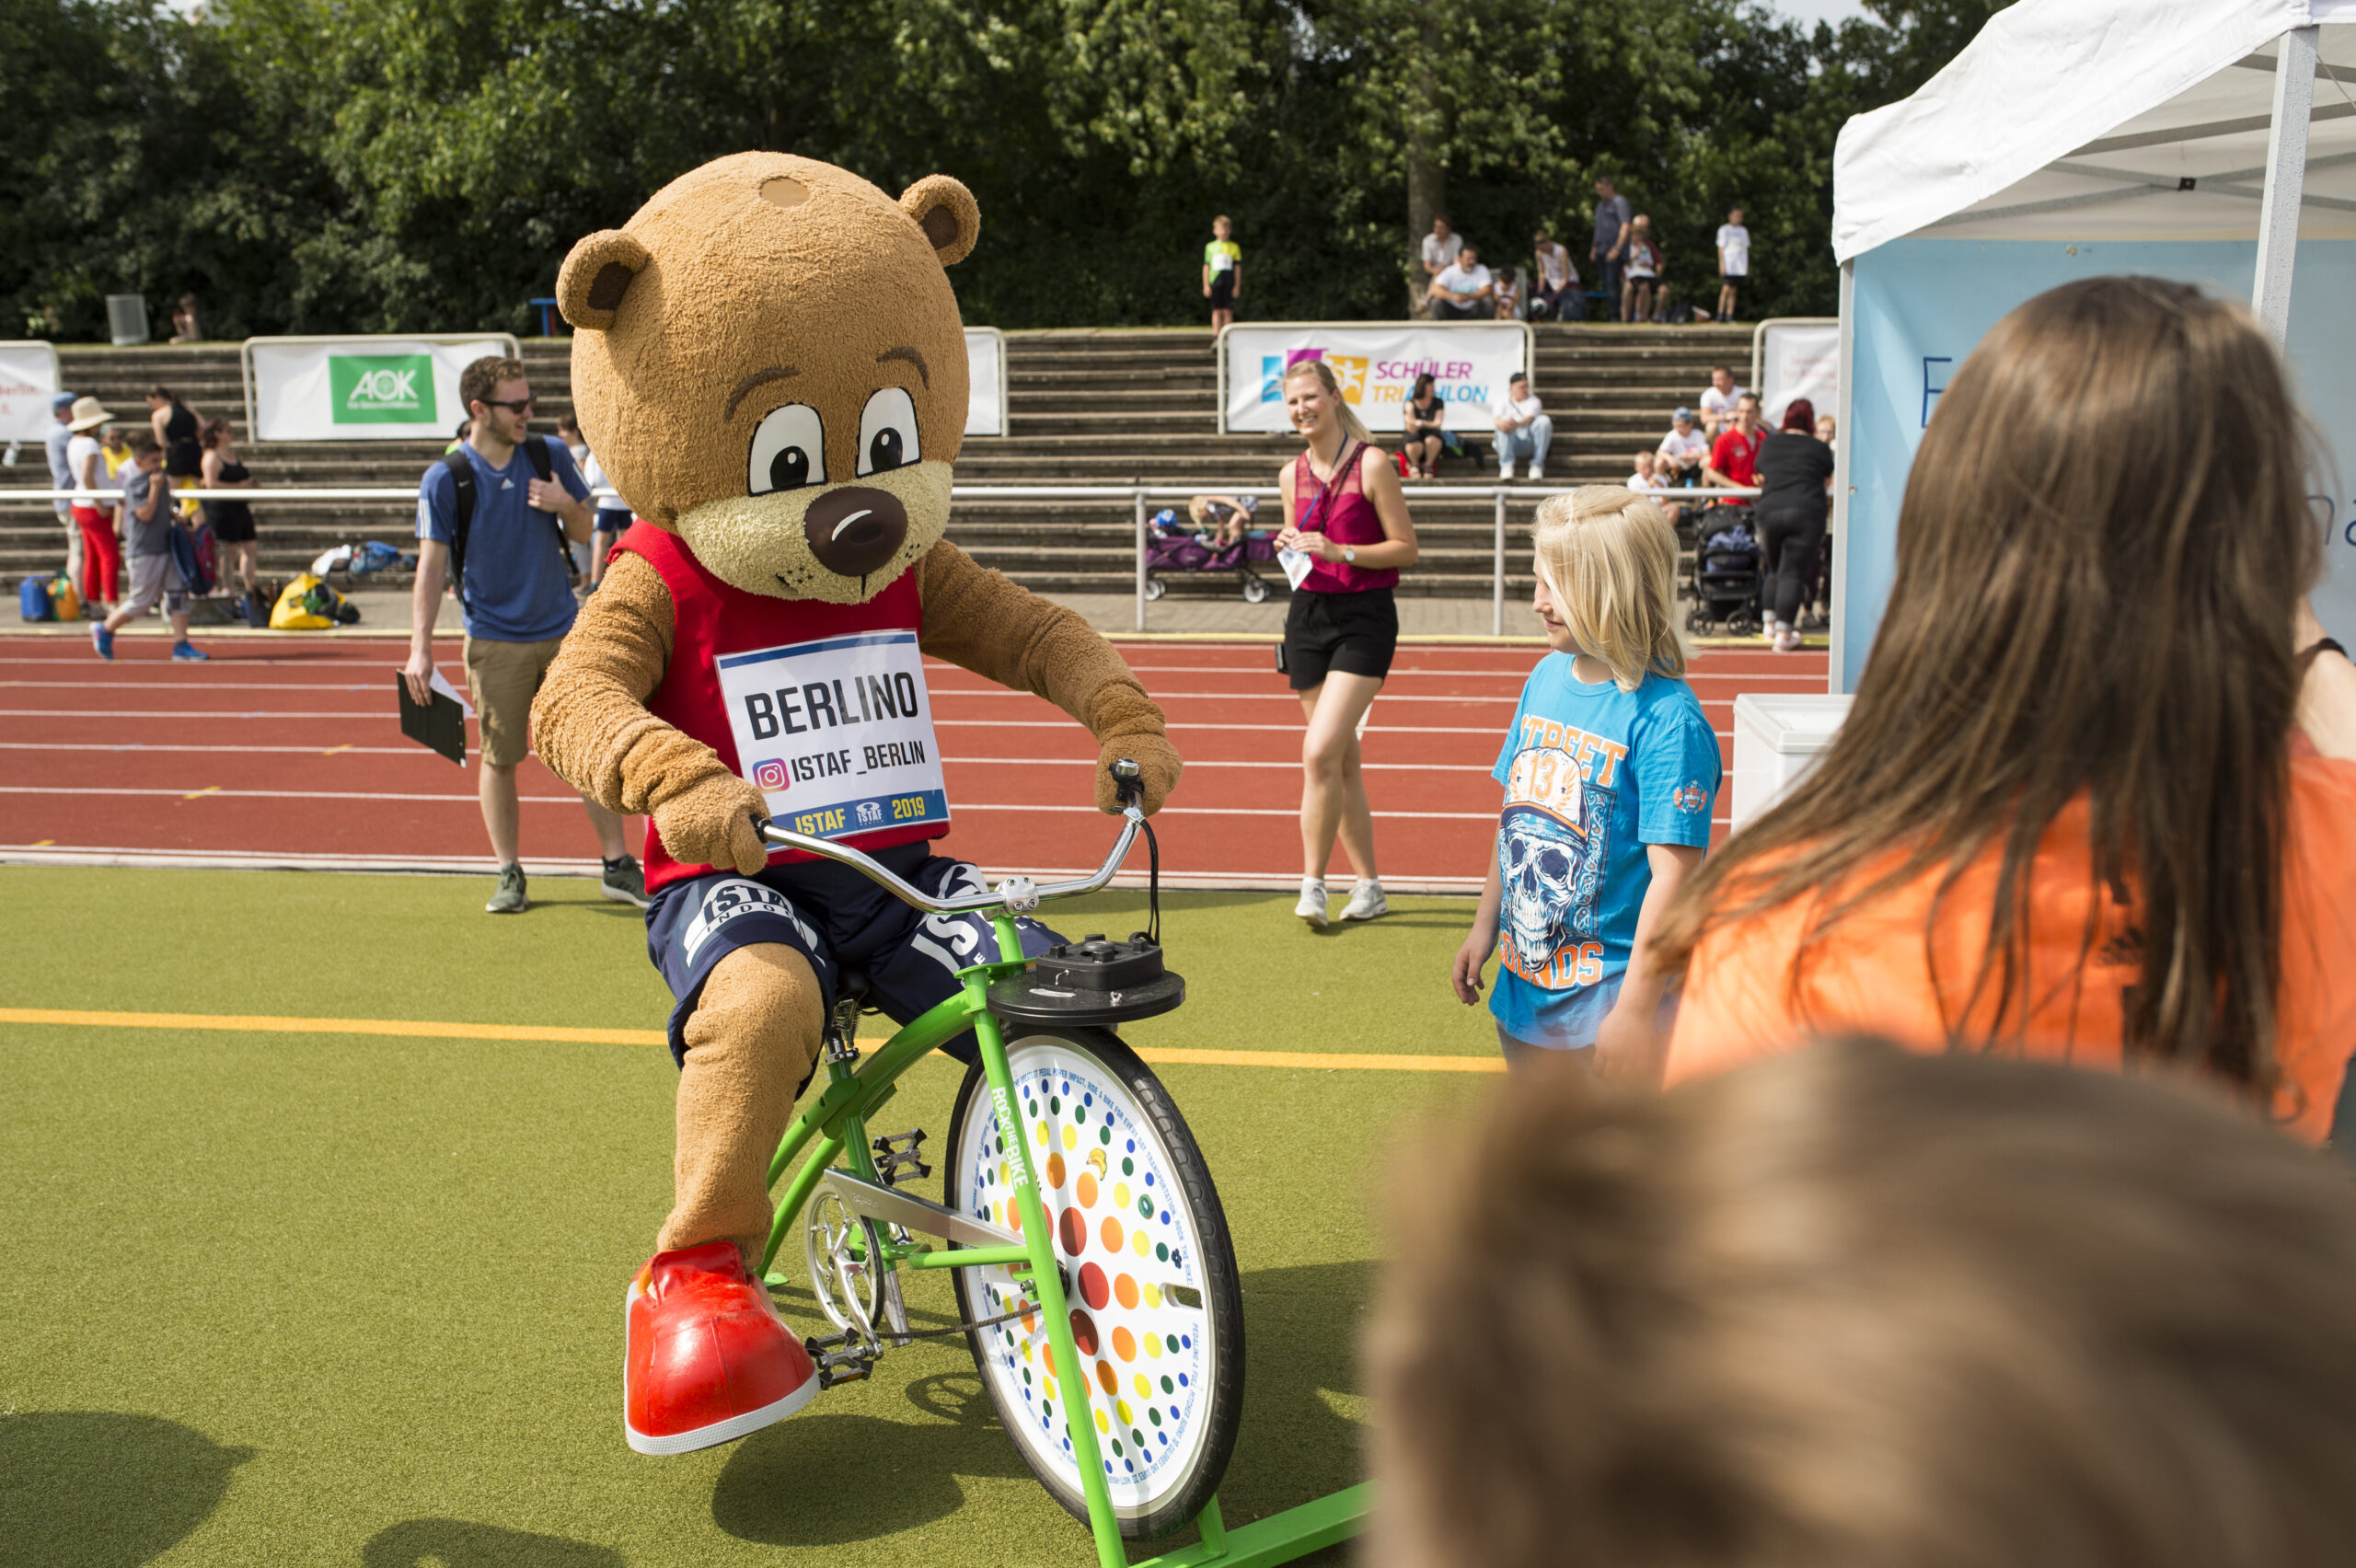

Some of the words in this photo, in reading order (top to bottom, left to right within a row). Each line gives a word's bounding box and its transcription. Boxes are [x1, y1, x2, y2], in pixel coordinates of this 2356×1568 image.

[349, 369, 419, 401] AOK
[1376, 357, 1472, 379] SCHÜLER
[745, 672, 918, 741] BERLINO
[1530, 754, 1557, 800] 13
[795, 808, 846, 836] ISTAF
[892, 796, 926, 819] 2019
[1103, 1092, 1114, 1110] BIKE
[1114, 1104, 1123, 1121] FOR
